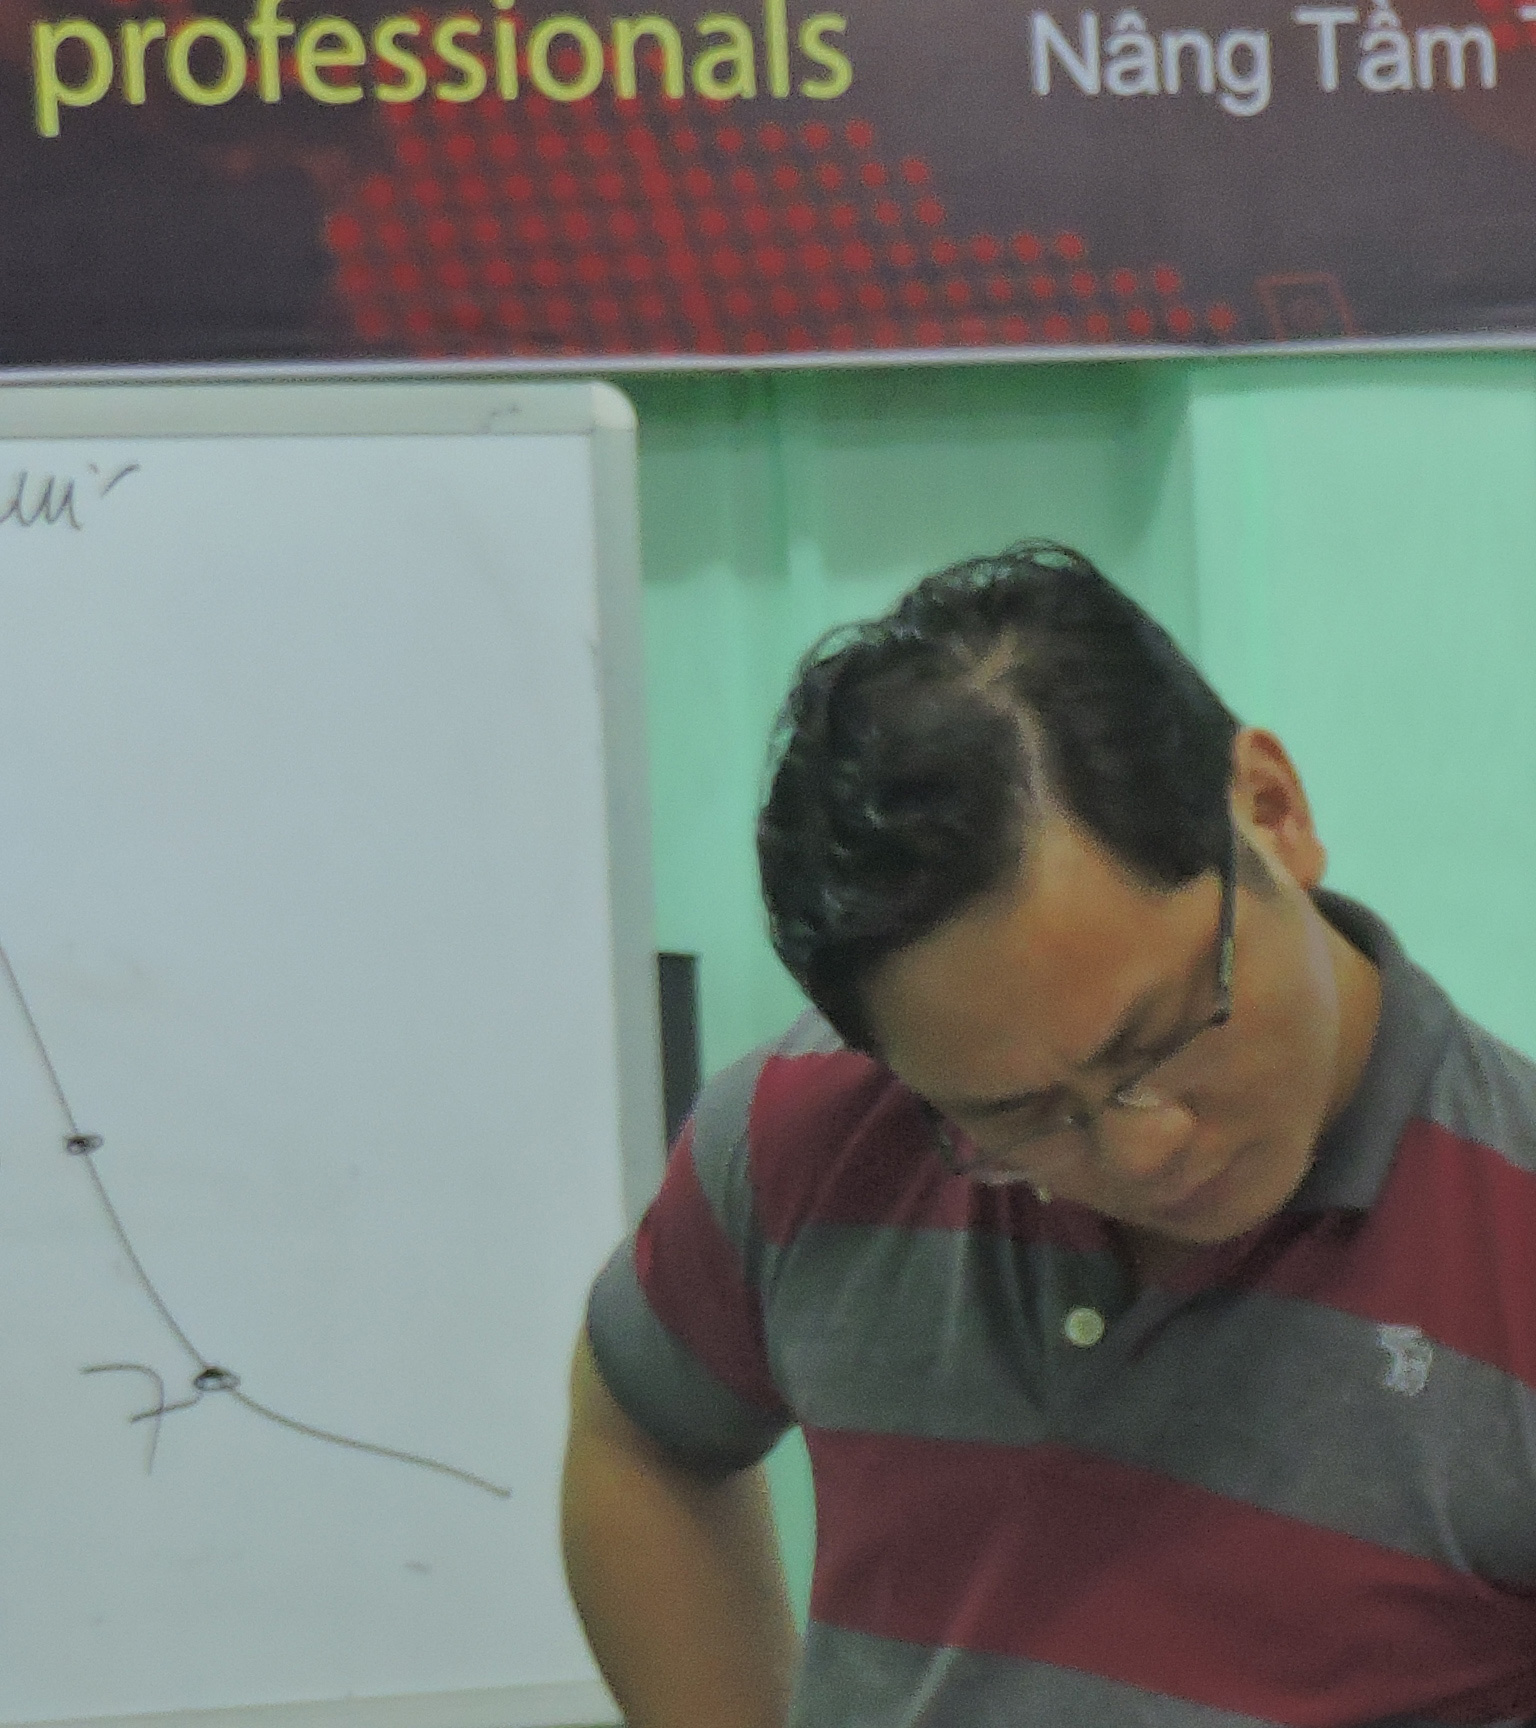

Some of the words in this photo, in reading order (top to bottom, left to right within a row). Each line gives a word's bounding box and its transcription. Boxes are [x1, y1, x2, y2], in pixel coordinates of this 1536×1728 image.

[33, 0, 853, 138] professionals
[1029, 6, 1271, 117] Nâng
[1293, 0, 1496, 93] Tầm
